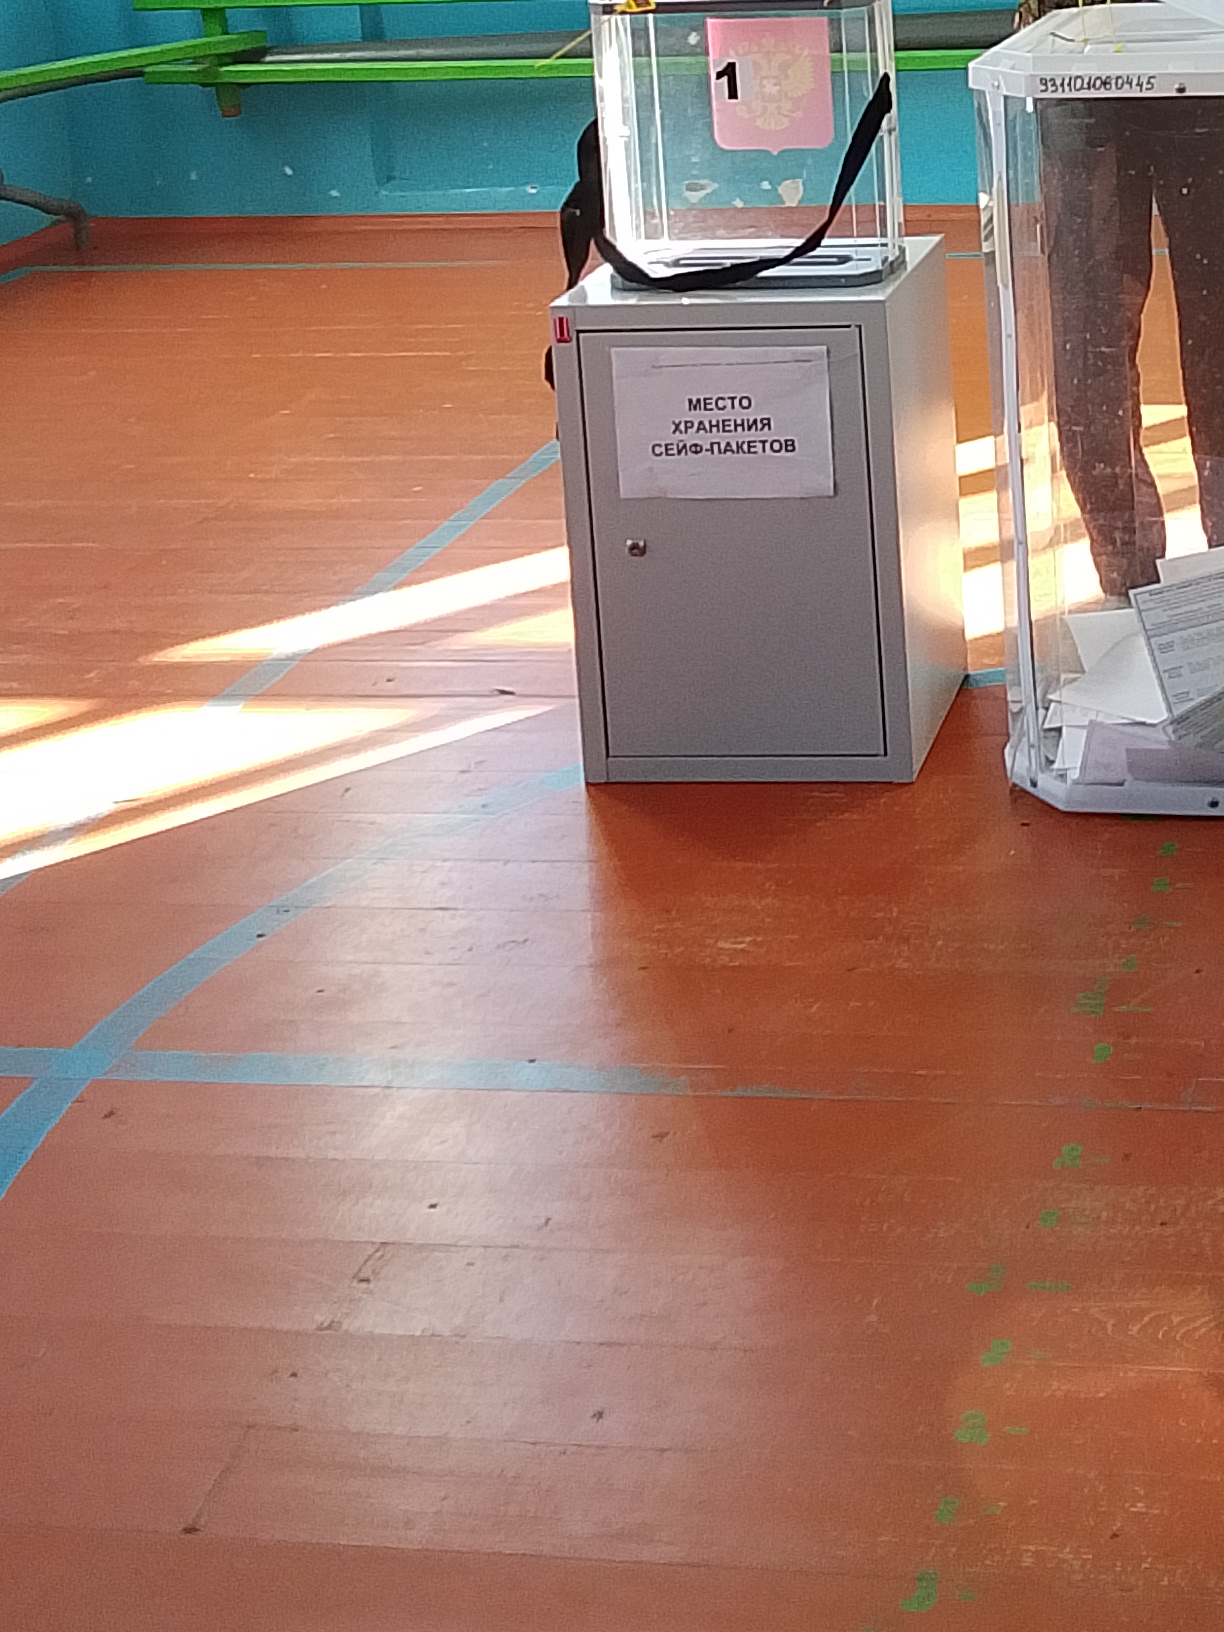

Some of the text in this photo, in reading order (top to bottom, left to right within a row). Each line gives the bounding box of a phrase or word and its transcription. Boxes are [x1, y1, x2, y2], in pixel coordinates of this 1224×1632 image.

[715, 61, 739, 101] 1
[687, 395, 752, 412] МЕСТО
[671, 417, 772, 435] ХРАНЕНИЯ
[651, 438, 796, 457] СЕЙФ-ПАКЕТОВ
